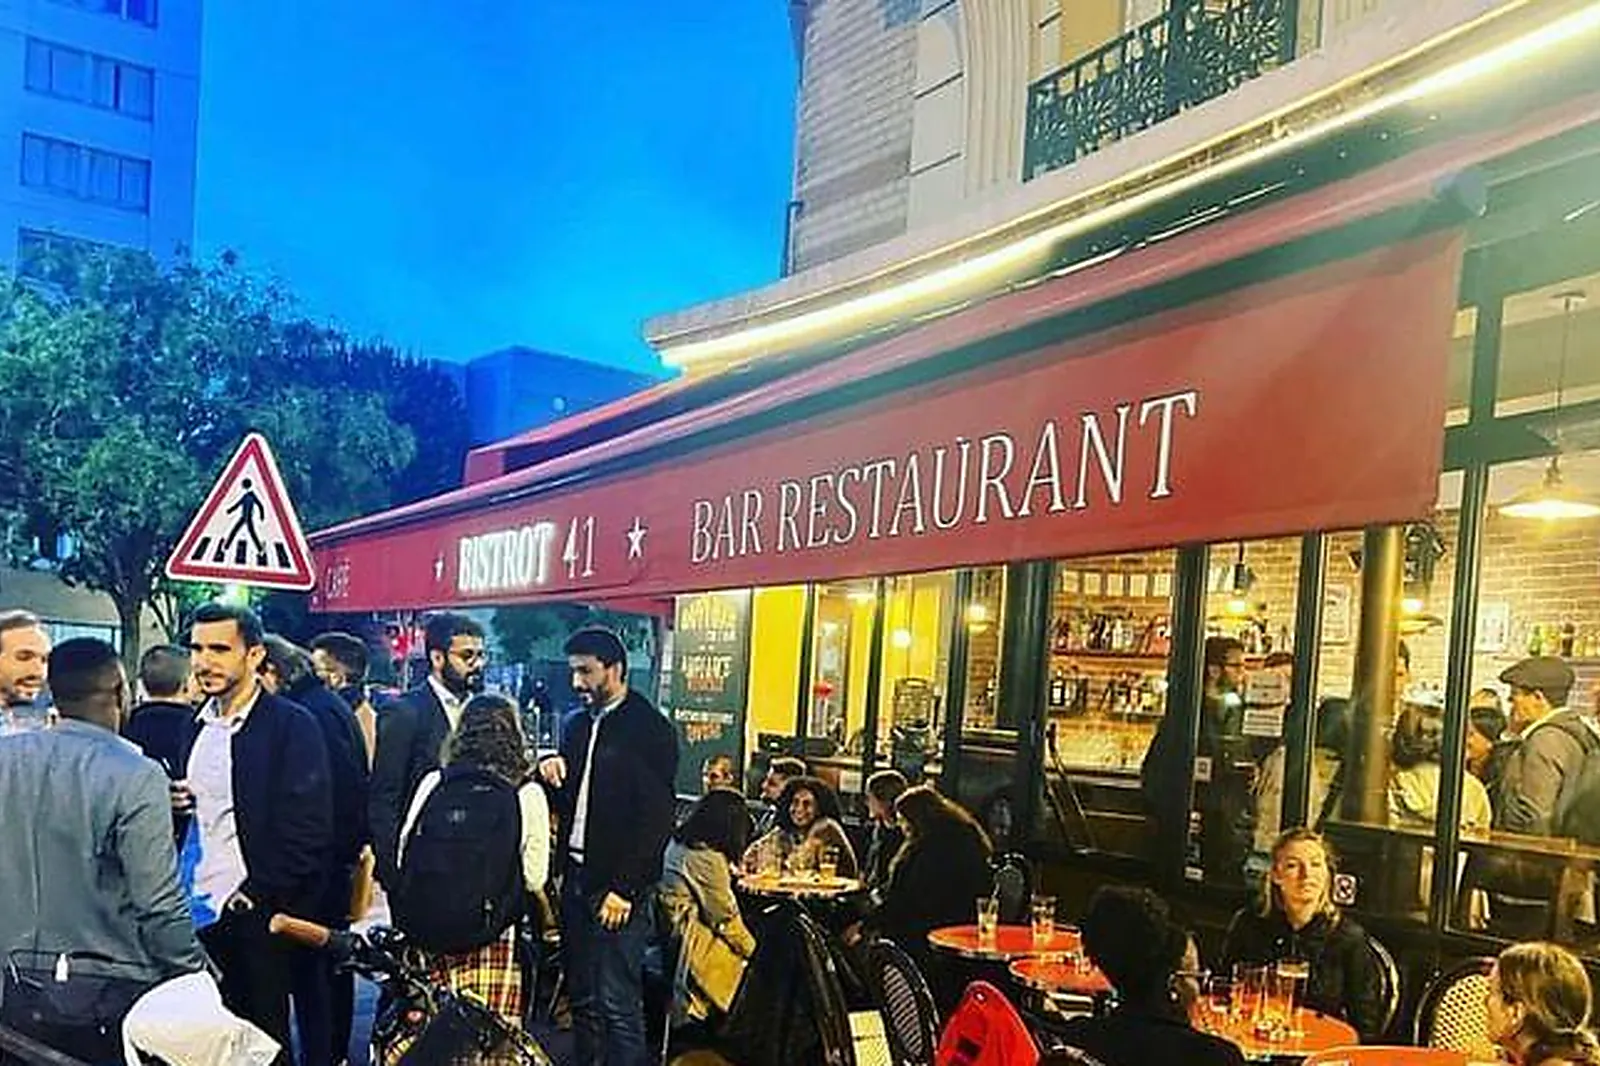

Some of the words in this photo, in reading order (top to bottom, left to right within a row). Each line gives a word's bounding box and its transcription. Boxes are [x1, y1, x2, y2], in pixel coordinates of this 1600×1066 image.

[458, 521, 555, 592] BISTROT
[562, 515, 597, 579] 41
[691, 490, 764, 564] BAR
[776, 391, 1197, 552] RESTAURANT
